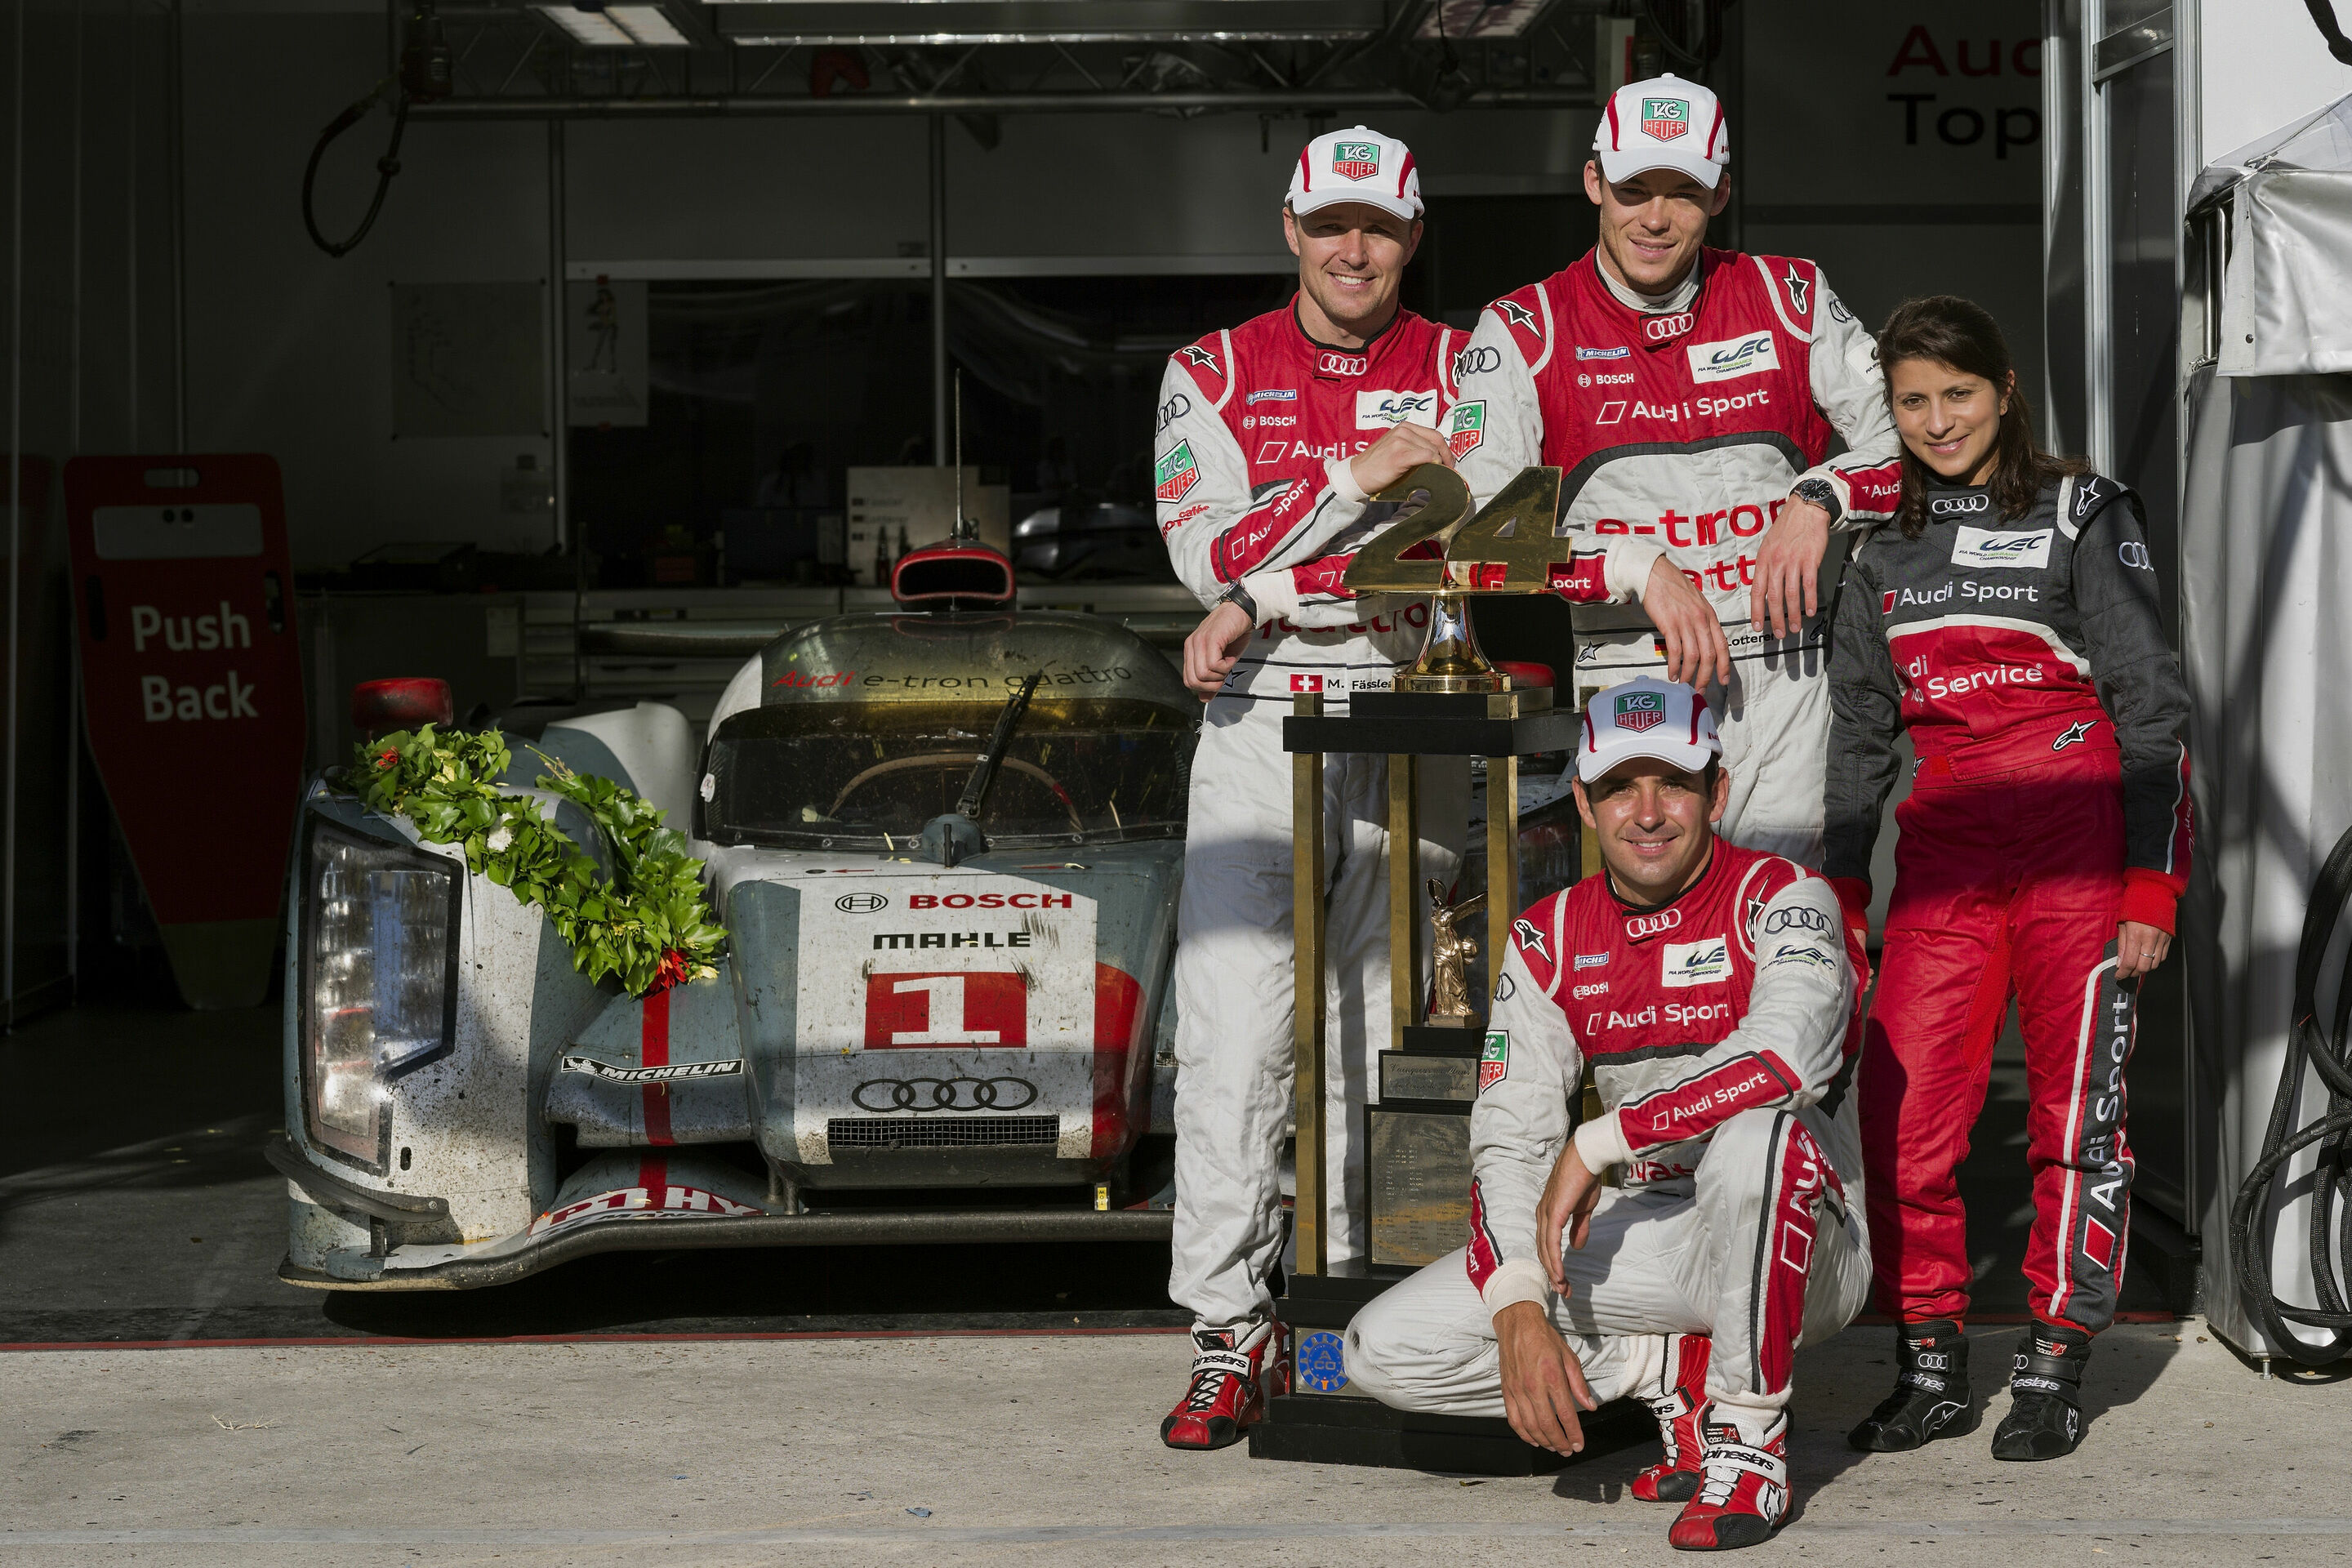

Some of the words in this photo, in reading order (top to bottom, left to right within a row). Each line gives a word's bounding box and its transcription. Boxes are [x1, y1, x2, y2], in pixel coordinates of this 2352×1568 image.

[1650, 101, 1682, 118] TAG
[1646, 122, 1684, 139] HEUER
[1886, 94, 2041, 159] Top
[1342, 145, 1373, 161] TAG
[1336, 163, 1374, 178] HEUER
[1585, 349, 1626, 357] MICHELIN
[1712, 338, 1770, 363] WEC
[1596, 373, 1634, 384] BOSCH
[1379, 397, 1433, 413] WEC
[1632, 400, 1691, 422] Audi
[1696, 389, 1769, 417] Sport
[1260, 416, 1296, 426] BOSCH
[1454, 407, 1477, 430] TAG
[1290, 441, 1347, 460] Audi
[1160, 452, 1186, 480] TAG
[1157, 470, 1195, 500] HEUER
[1871, 479, 1901, 498] Aud
[1343, 462, 1572, 588] 24
[1980, 536, 2047, 551] WEC
[1552, 577, 1591, 590] port
[1900, 581, 1953, 607] Audi
[1961, 581, 2038, 603] Sport
[130, 601, 252, 653] Push
[771, 670, 857, 688] Audi
[863, 672, 989, 688] e-tron
[1327, 679, 1344, 688] M.
[140, 670, 259, 723] Back
[1623, 695, 1657, 710] TAG
[1619, 712, 1660, 728] HEUER
[909, 893, 1072, 909] BOSCH
[873, 932, 1031, 950] MAHLE
[892, 976, 1000, 1045] 1
[1607, 1005, 1656, 1030] Audi
[601, 1062, 737, 1080] MICHELIN
[1673, 1094, 1712, 1121] Audi
[1715, 1072, 1767, 1103] Sport
